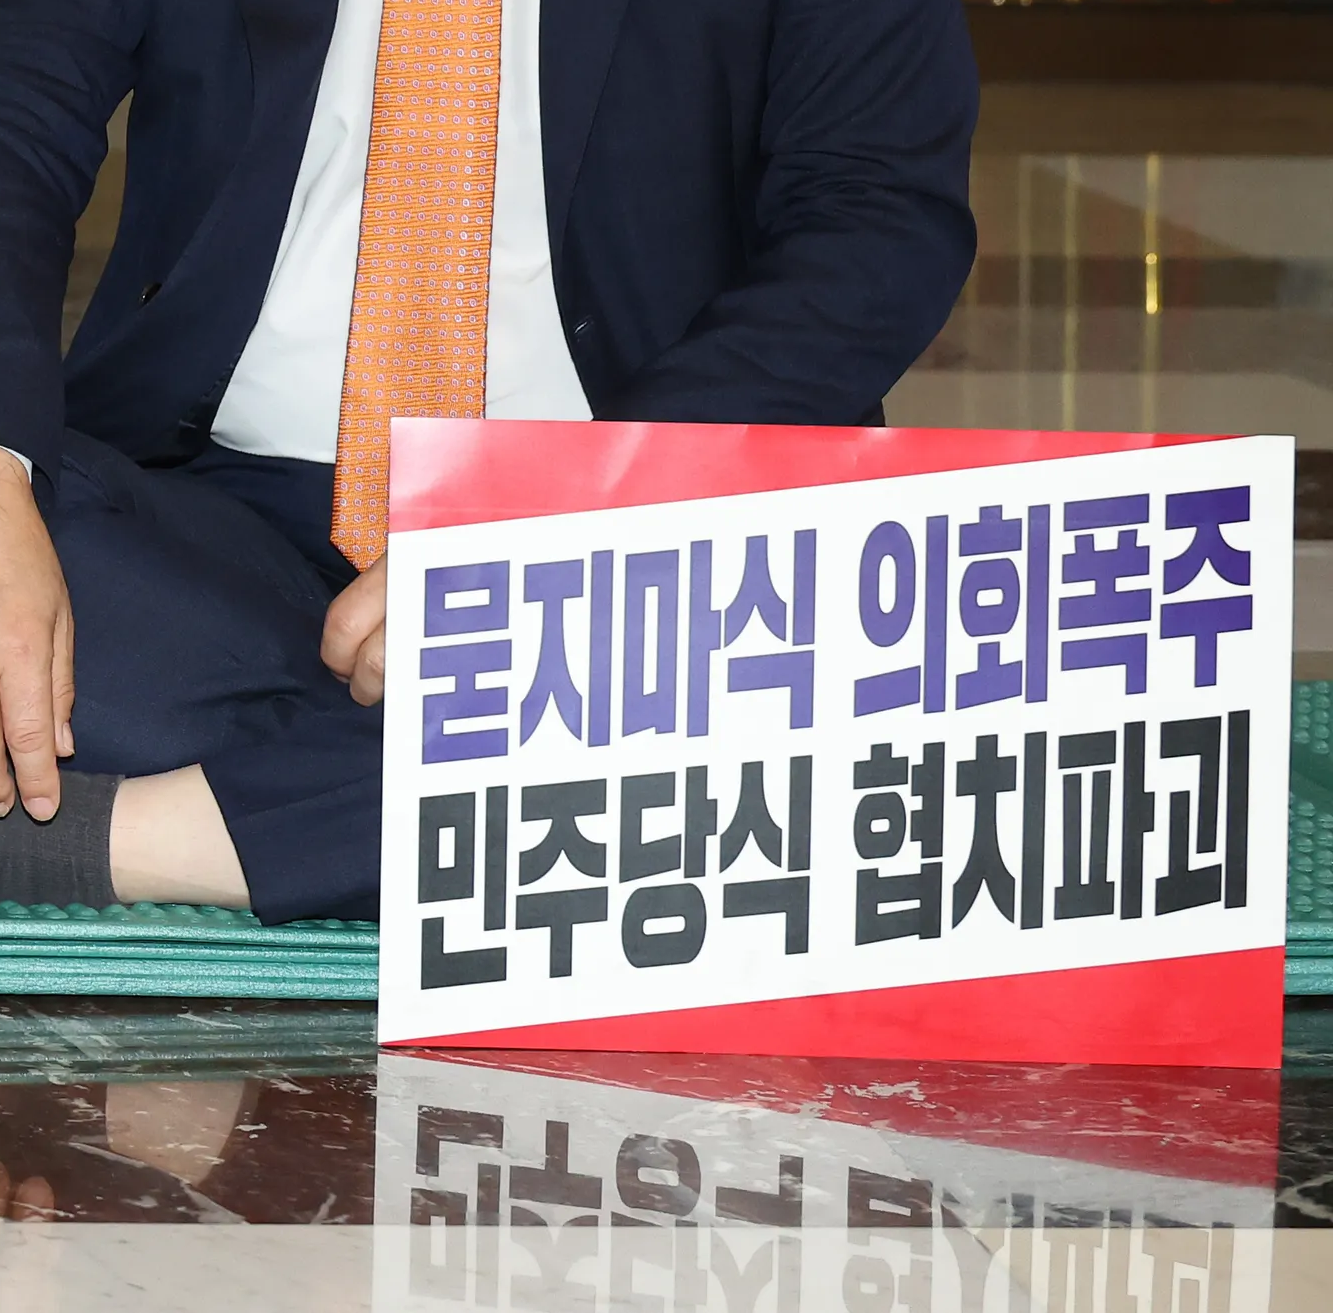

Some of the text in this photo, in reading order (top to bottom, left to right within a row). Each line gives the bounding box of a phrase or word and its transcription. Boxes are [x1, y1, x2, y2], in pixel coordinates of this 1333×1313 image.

[420, 485, 1253, 765] 묻지마식 의회폭주
[418, 709, 1251, 991] 민주당식 협치파괴
